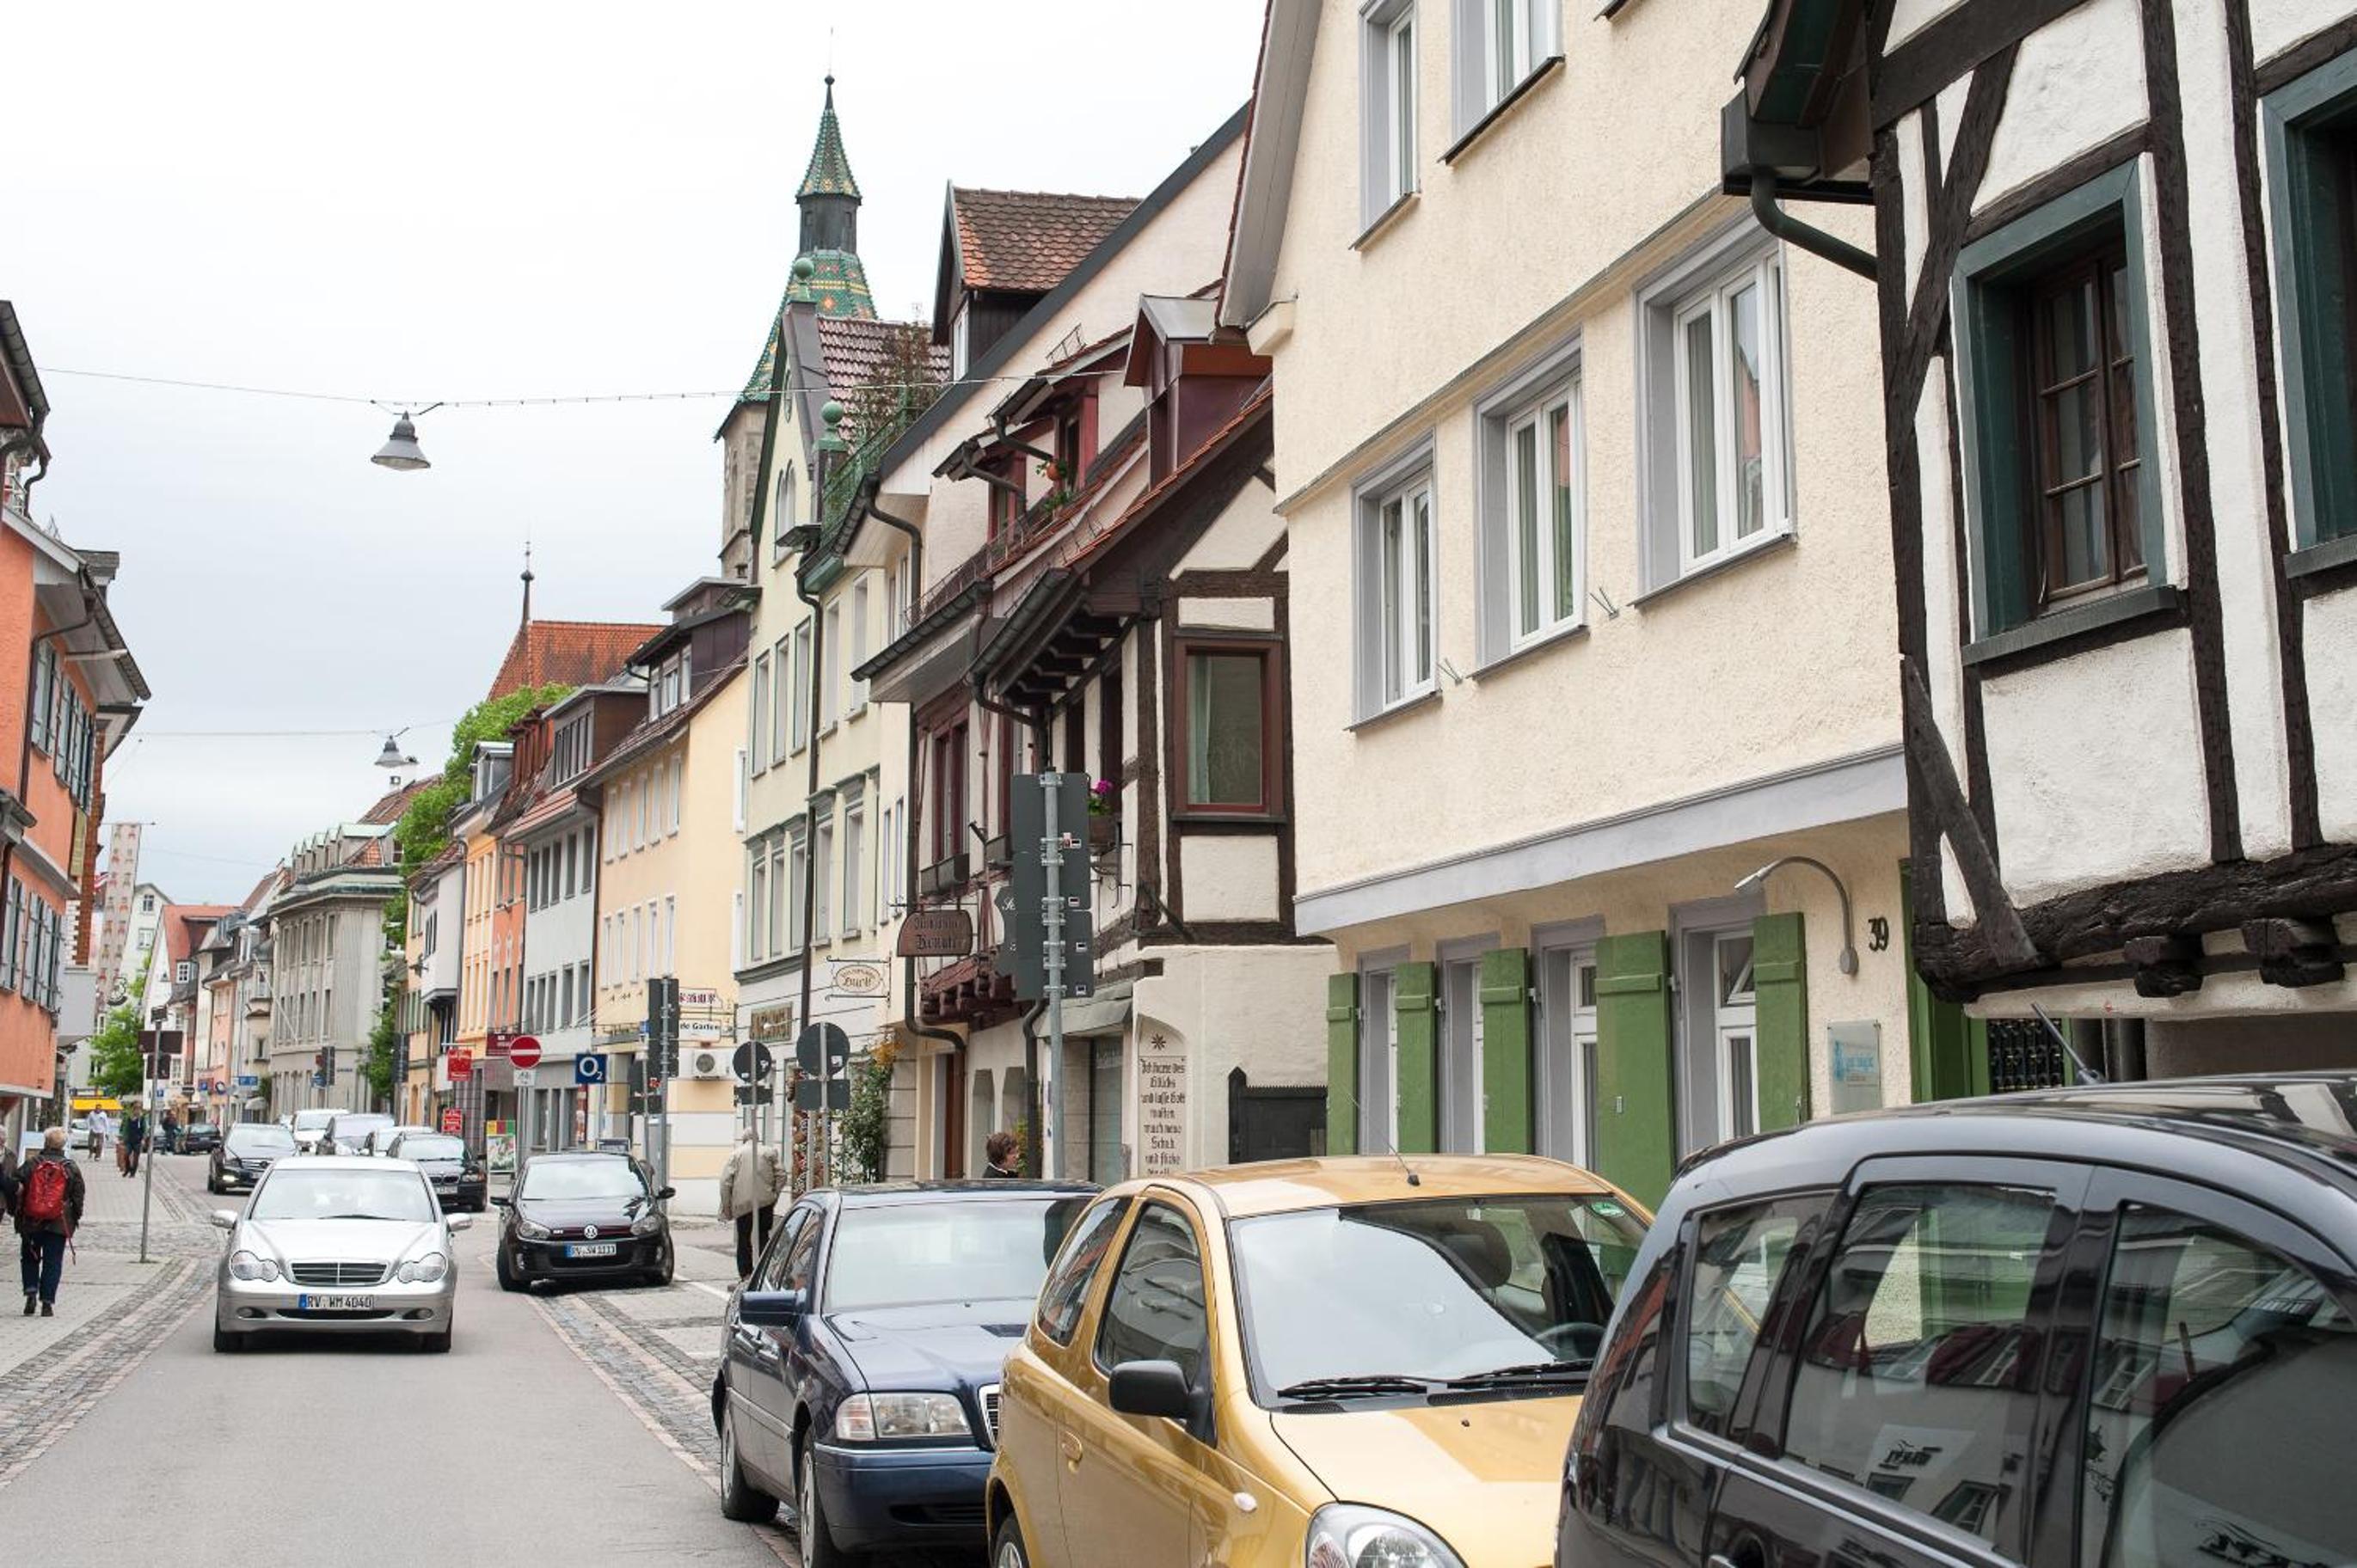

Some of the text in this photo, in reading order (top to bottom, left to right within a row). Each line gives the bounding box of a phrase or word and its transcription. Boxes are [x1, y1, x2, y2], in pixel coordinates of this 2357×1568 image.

[1868, 916, 1889, 952] 39
[308, 1295, 321, 1307] RV
[346, 1295, 371, 1308] 4040
